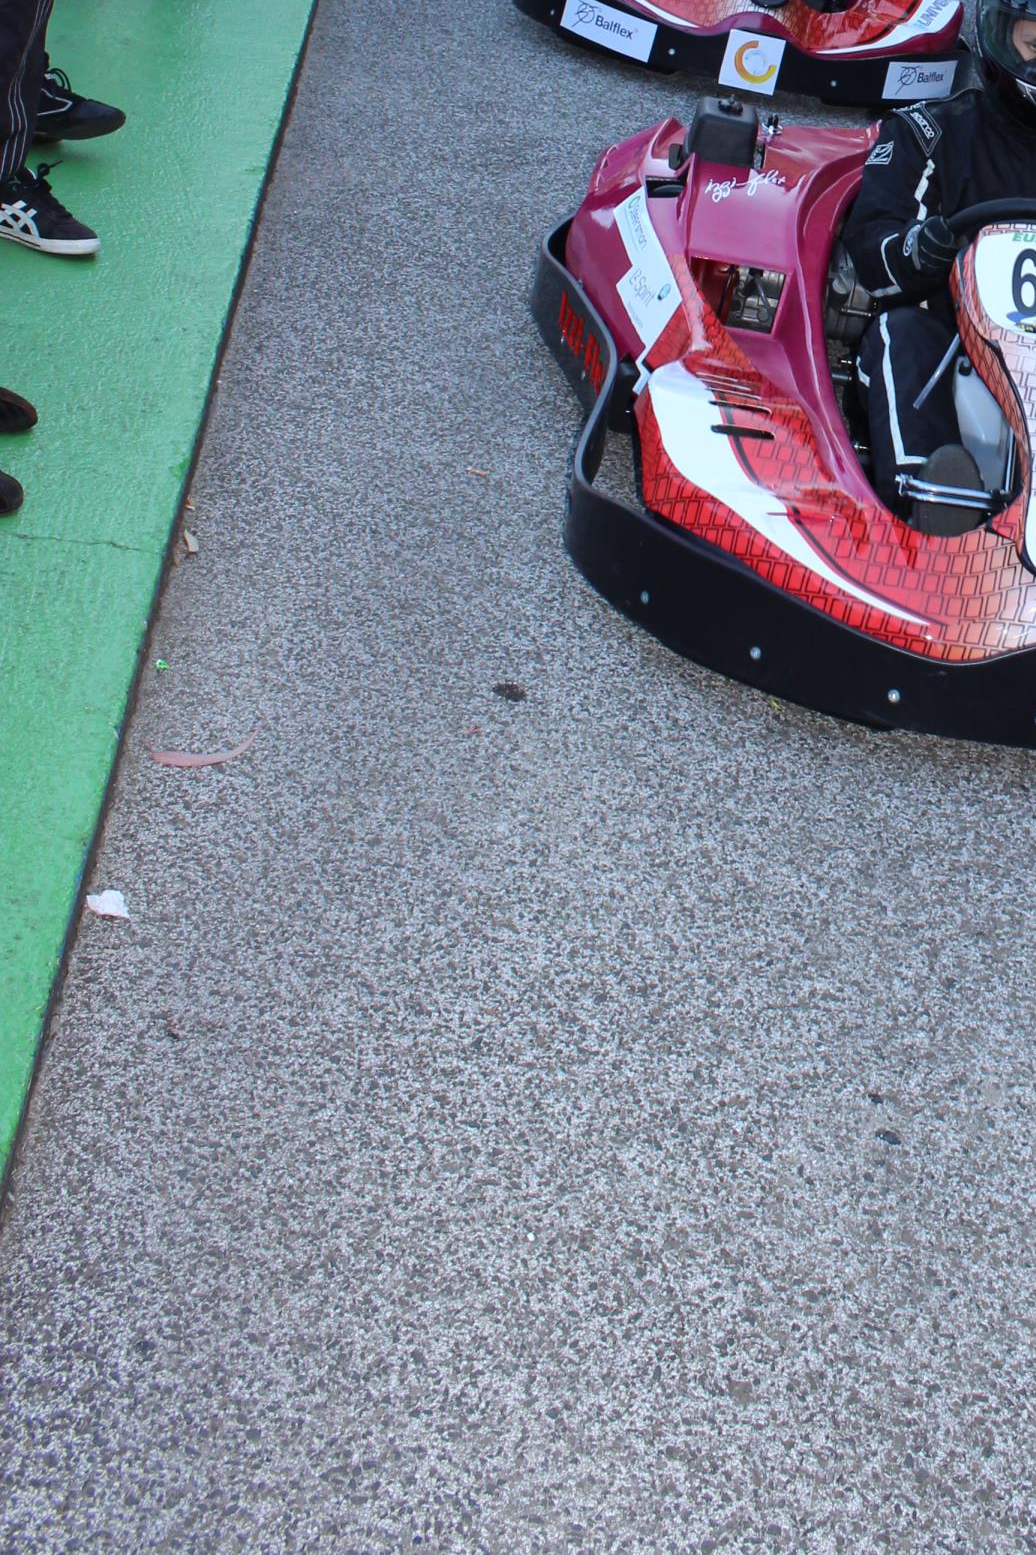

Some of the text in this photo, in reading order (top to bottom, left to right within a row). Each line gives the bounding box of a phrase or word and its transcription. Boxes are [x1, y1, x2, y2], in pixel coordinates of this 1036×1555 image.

[594, 14, 635, 40] Balflex
[916, 71, 945, 84] Balflex
[910, 111, 935, 139] sparco
